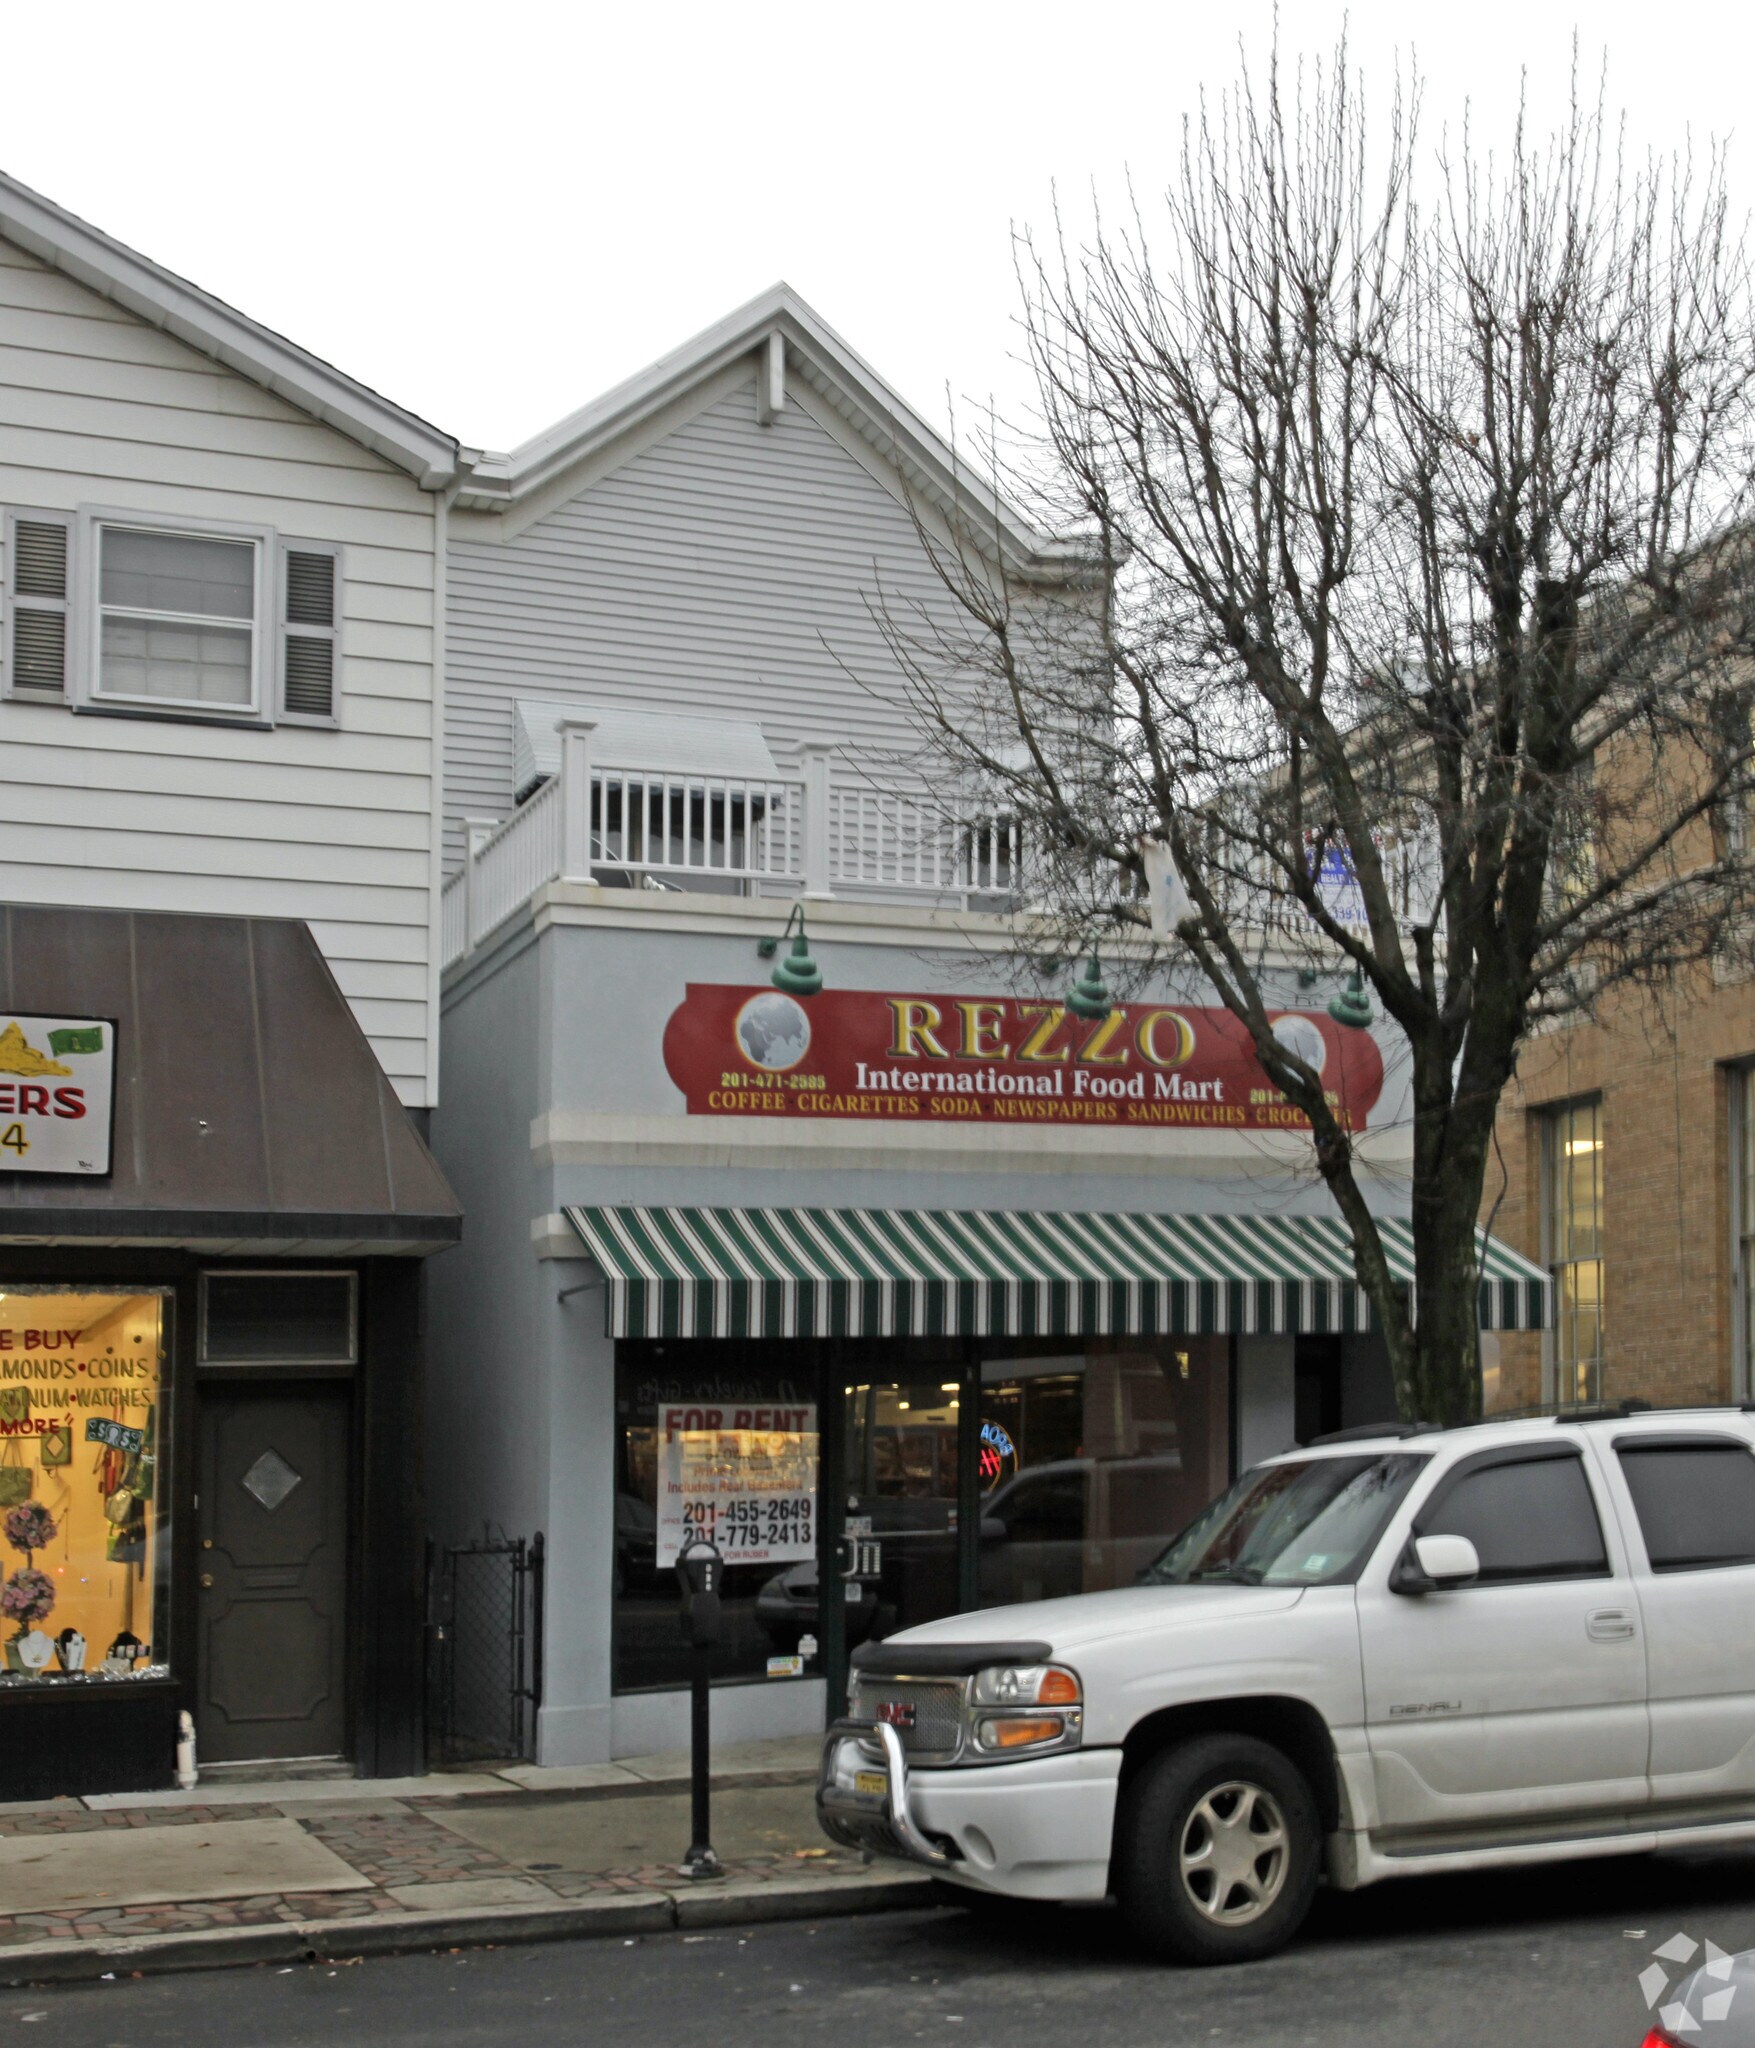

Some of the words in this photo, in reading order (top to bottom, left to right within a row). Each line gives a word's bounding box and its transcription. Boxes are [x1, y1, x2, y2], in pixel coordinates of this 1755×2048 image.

[887, 999, 1196, 1068] REZZO
[855, 1062, 1063, 1096] International
[1073, 1070, 1144, 1099] Food
[1154, 1073, 1224, 1101] Mart
[708, 1091, 785, 1110] COFFEE
[797, 1093, 919, 1115] CIGARETTES
[931, 1096, 982, 1116] SODA
[993, 1099, 1117, 1120] NEWSPAPERS
[1127, 1102, 1246, 1123] SANDWICHES
[24, 1329, 82, 1351] BUY
[0, 1359, 77, 1379] MONDS
[87, 1358, 149, 1379] COINS
[75, 1388, 152, 1408] WATCHES
[665, 1409, 723, 1444] FOR
[733, 1408, 809, 1444] RENT
[683, 1498, 811, 1524] 201-455-2649
[683, 1522, 811, 1547] 201-779-2413
[1389, 1700, 1462, 1715] DENALI
